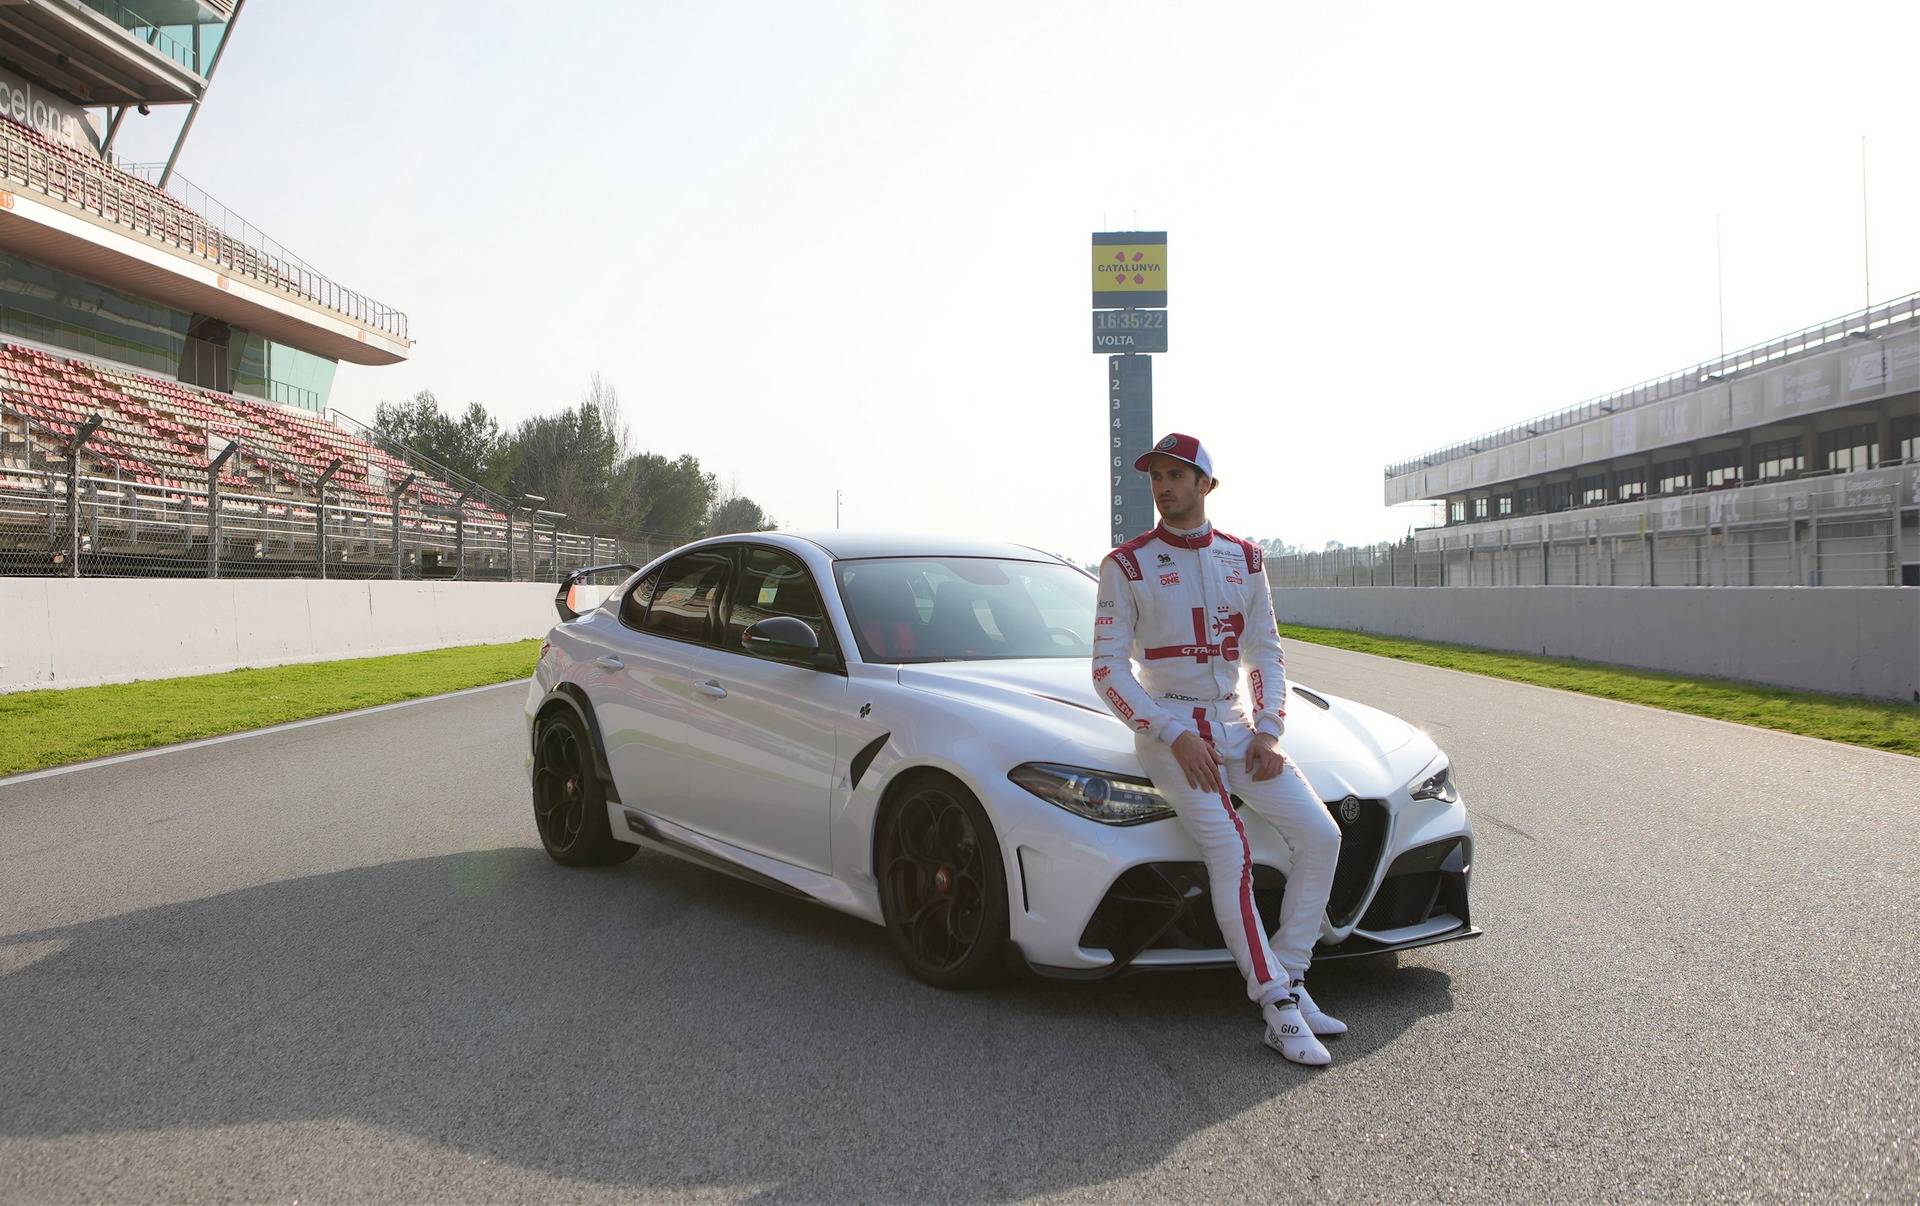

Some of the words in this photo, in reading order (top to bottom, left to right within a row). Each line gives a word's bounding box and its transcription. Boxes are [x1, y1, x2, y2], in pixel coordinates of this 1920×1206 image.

[2, 193, 15, 209] 19
[1098, 263, 1161, 273] CATALUNYA
[1097, 312, 1164, 329] 16:35:22
[1096, 335, 1135, 346] VOLTA
[1112, 361, 1119, 371] 1
[1112, 380, 1121, 390] 2
[1112, 399, 1121, 409] 3
[1112, 418, 1122, 428] 4
[1113, 437, 1122, 448] 5
[1113, 456, 1122, 467] 6
[1114, 475, 1122, 487] 7
[1113, 495, 1123, 506] 8
[1114, 514, 1123, 525] 9
[1113, 533, 1125, 545] 10
[1115, 552, 1138, 579] sparco
[1159, 572, 1179, 580] EIGHTY
[1160, 577, 1181, 586] ONE
[1107, 690, 1133, 718] ORLEN
[1281, 1024, 1300, 1035] GIO
